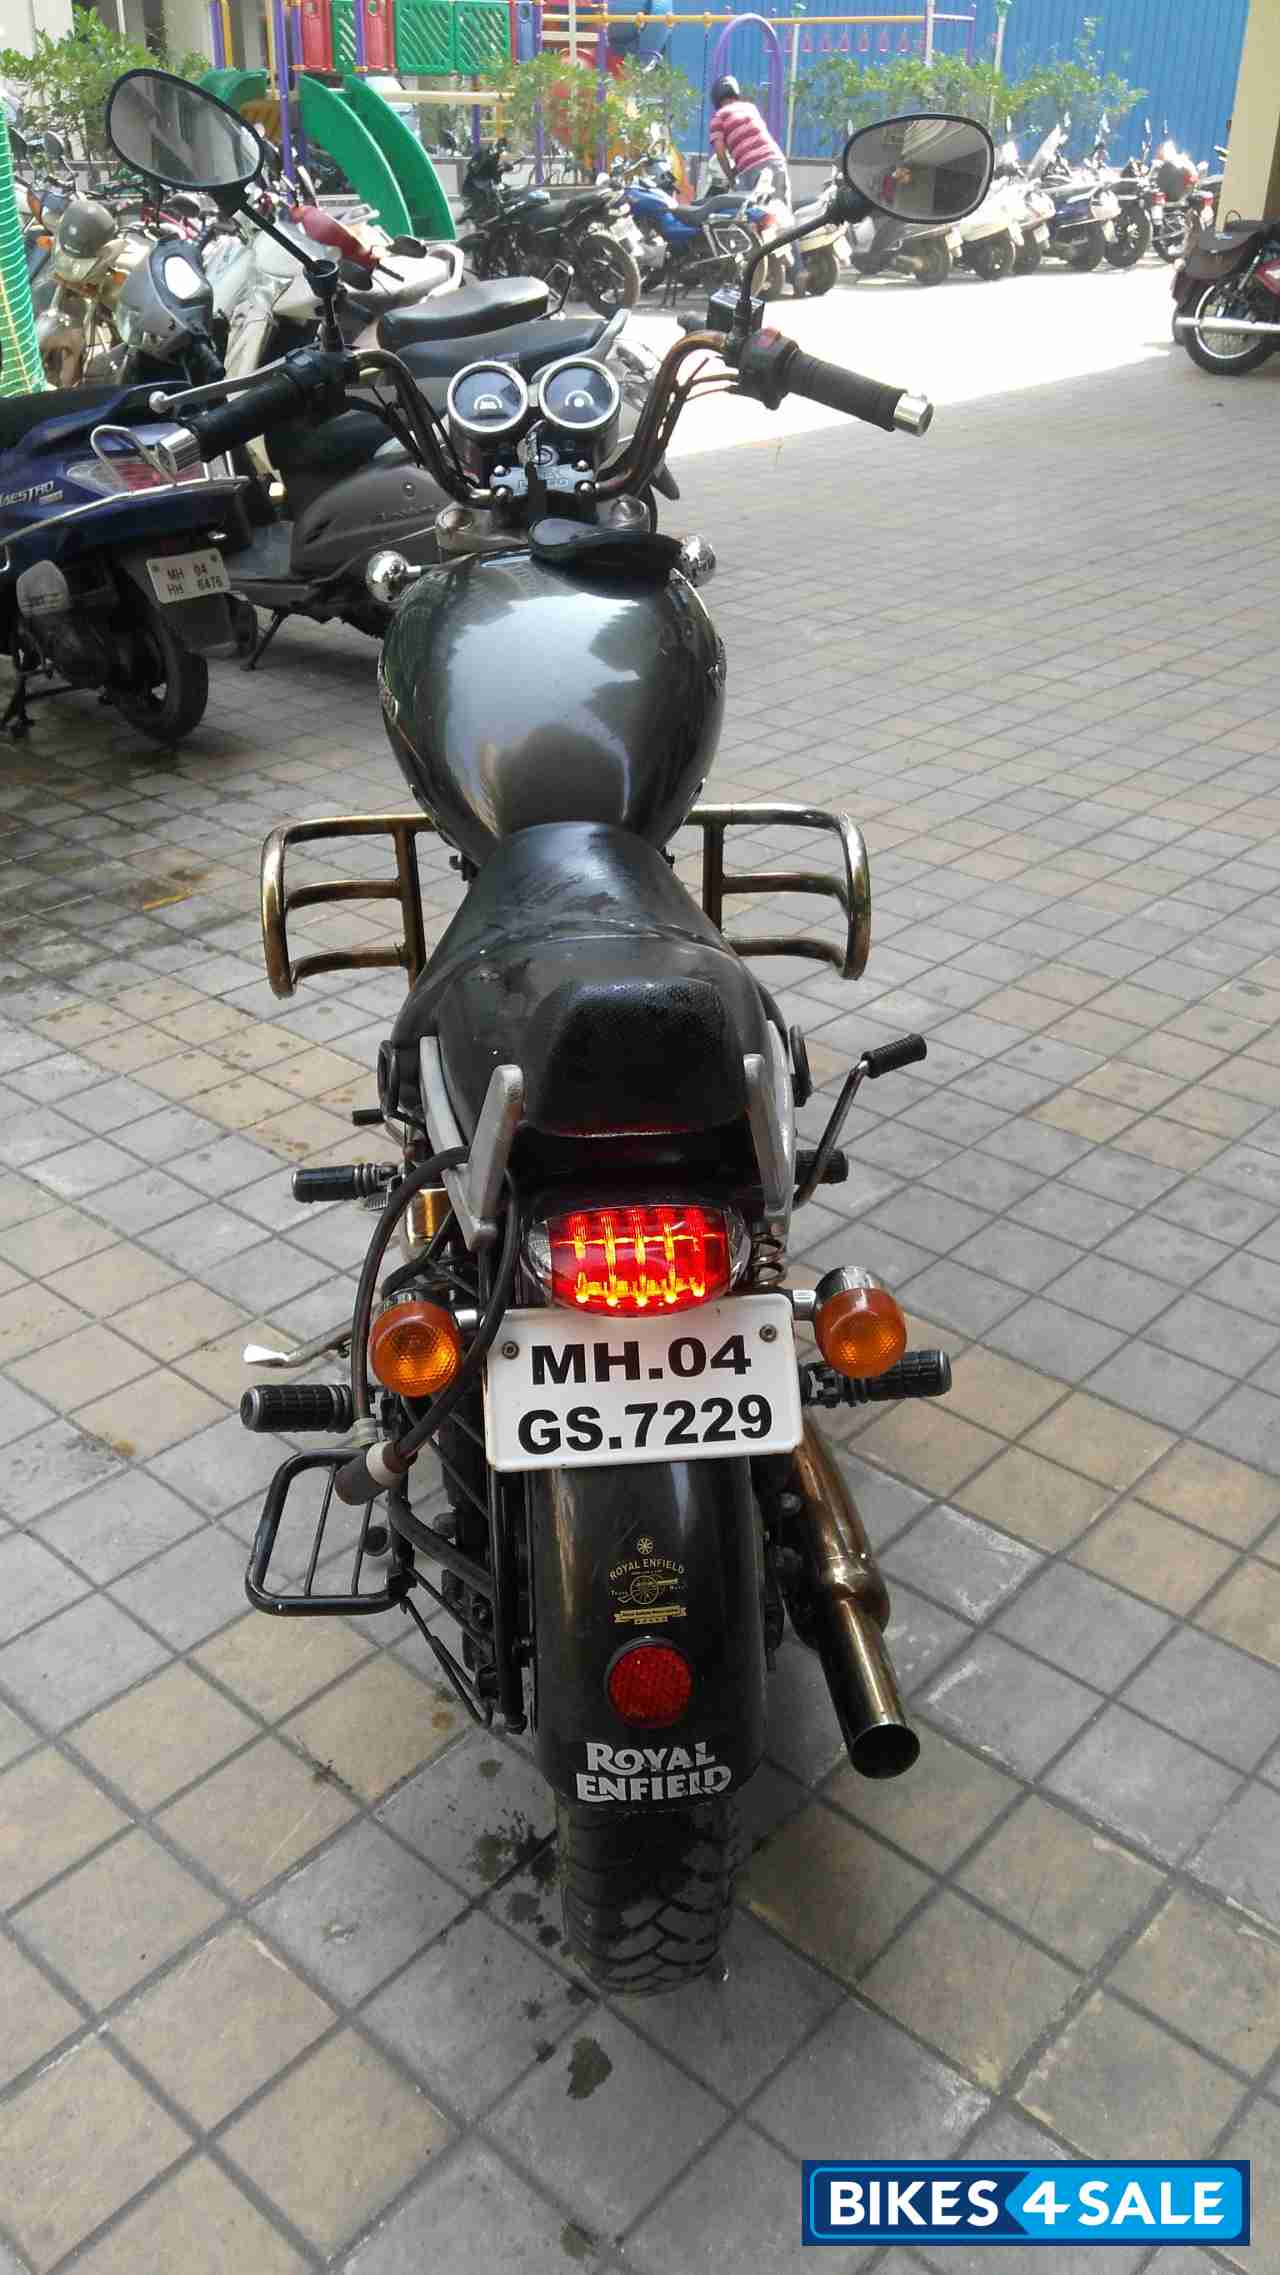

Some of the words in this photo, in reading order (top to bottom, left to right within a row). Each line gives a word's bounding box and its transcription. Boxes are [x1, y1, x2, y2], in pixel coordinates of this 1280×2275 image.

[167, 567, 185, 580] MH
[531, 1335, 752, 1385] MH.04
[518, 1394, 772, 1455] GS.7229
[609, 1560, 640, 1581] ROYAL
[643, 1558, 685, 1575] ENFIELD
[585, 1742, 716, 1776] ROYAL
[576, 1765, 732, 1803] ENFIELD
